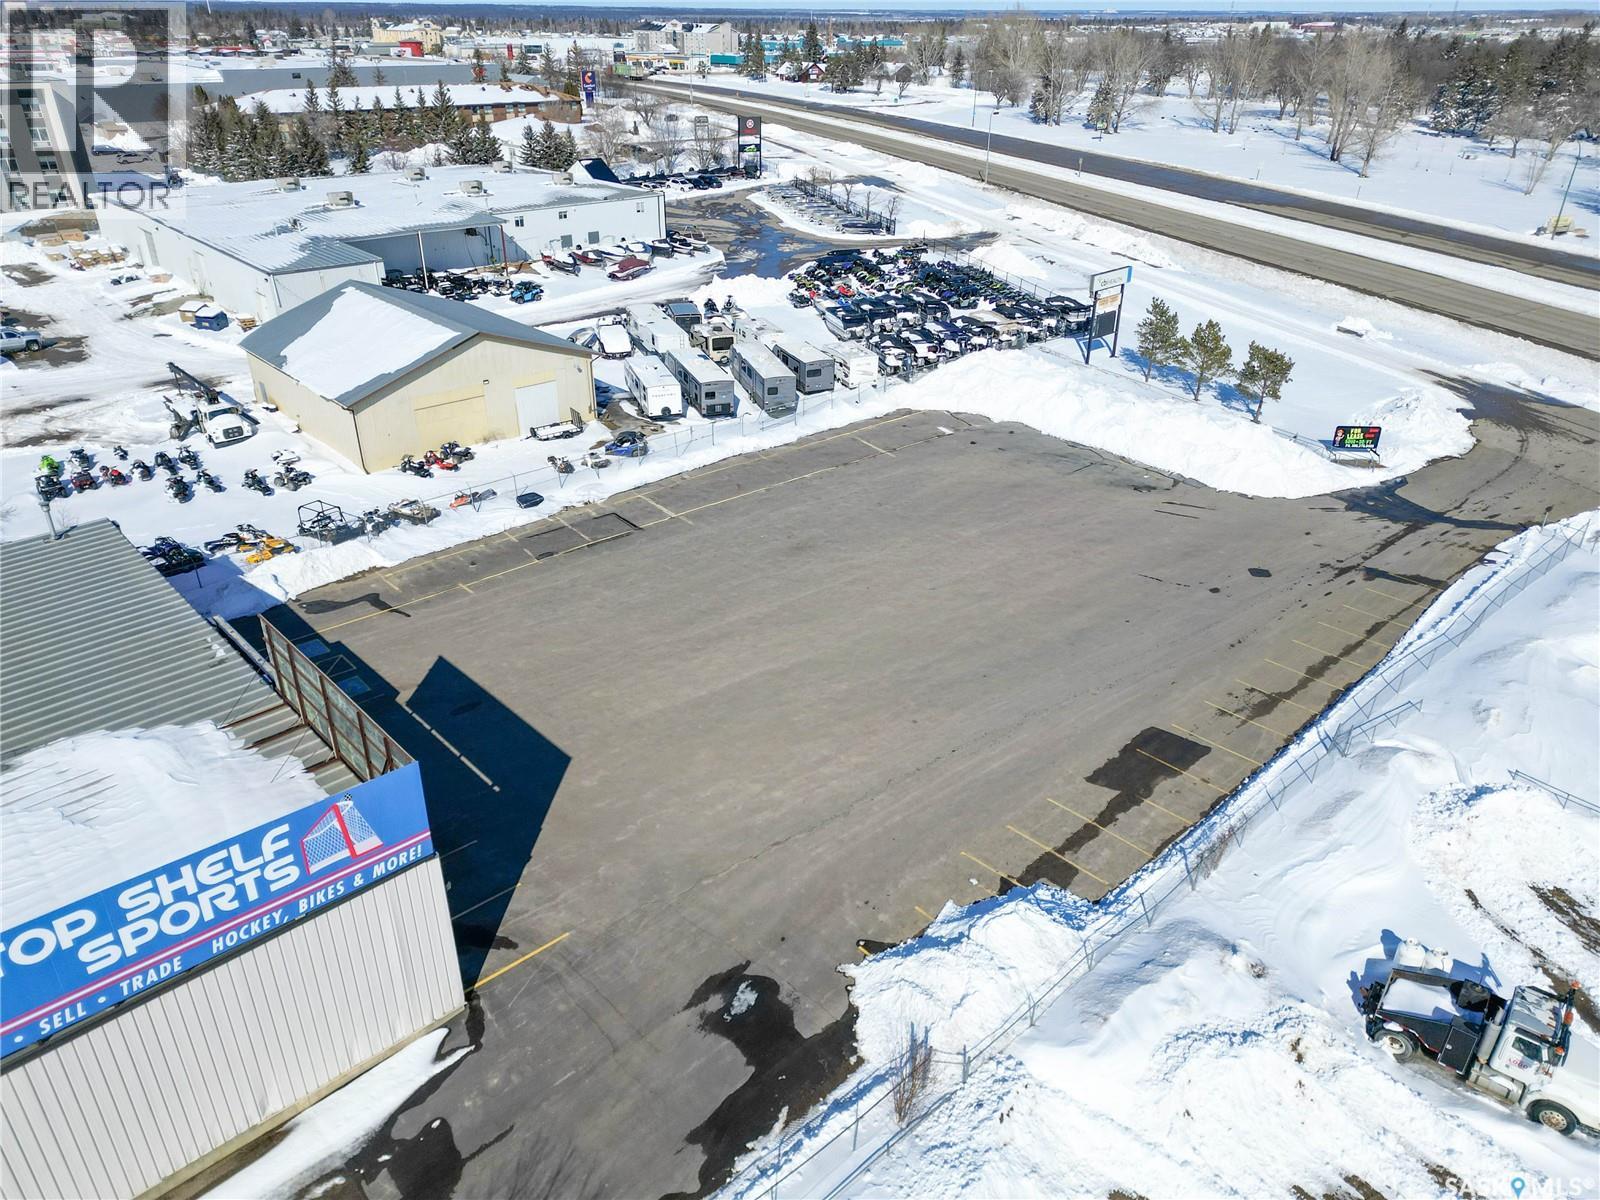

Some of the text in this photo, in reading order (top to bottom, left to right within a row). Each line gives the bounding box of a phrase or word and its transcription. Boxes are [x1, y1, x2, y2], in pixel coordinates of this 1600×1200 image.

[0, 823, 290, 977] OP SHELF
[39, 844, 423, 1034] SELL TRADE HOCKEY, BIKES & MORE!
[77, 854, 300, 975] SPORTS
